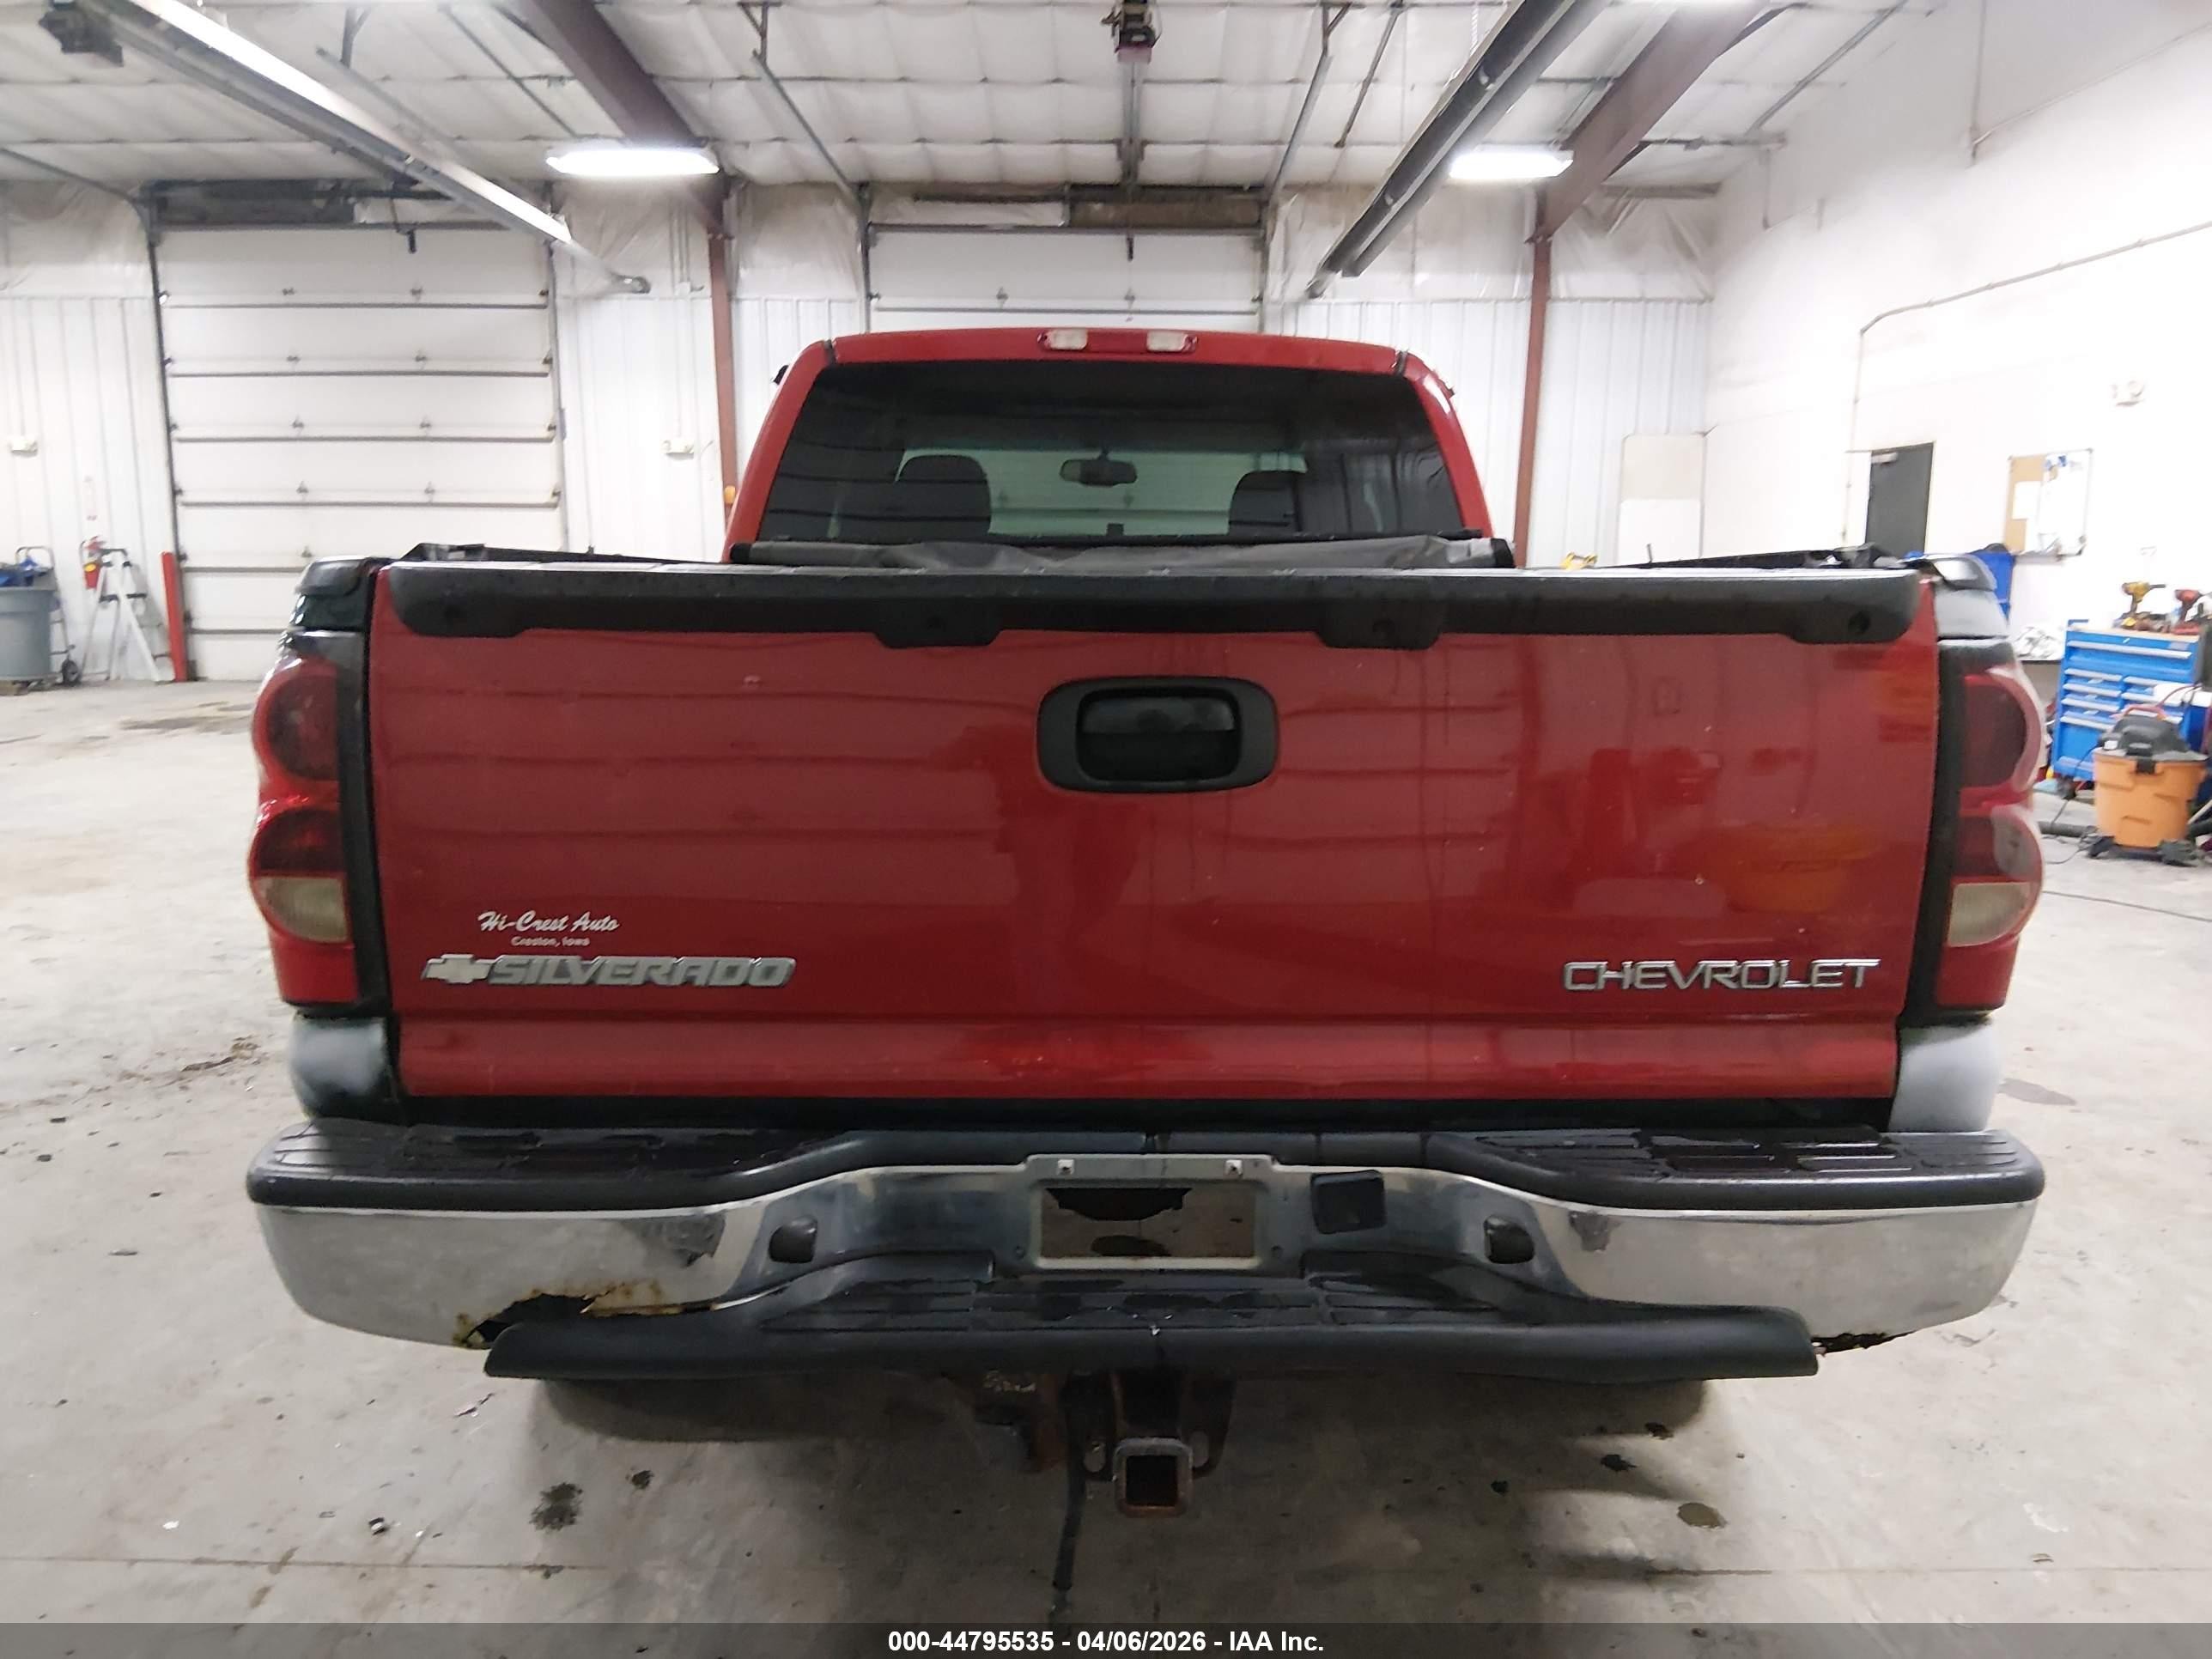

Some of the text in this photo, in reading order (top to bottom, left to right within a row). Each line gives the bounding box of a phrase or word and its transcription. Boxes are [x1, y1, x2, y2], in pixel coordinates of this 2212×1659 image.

[477, 910, 620, 932] Hi-Crest Auto
[562, 937, 591, 947] Iowa
[489, 955, 796, 987] SILVERADO
[1564, 959, 1881, 990] CHEVROLET
